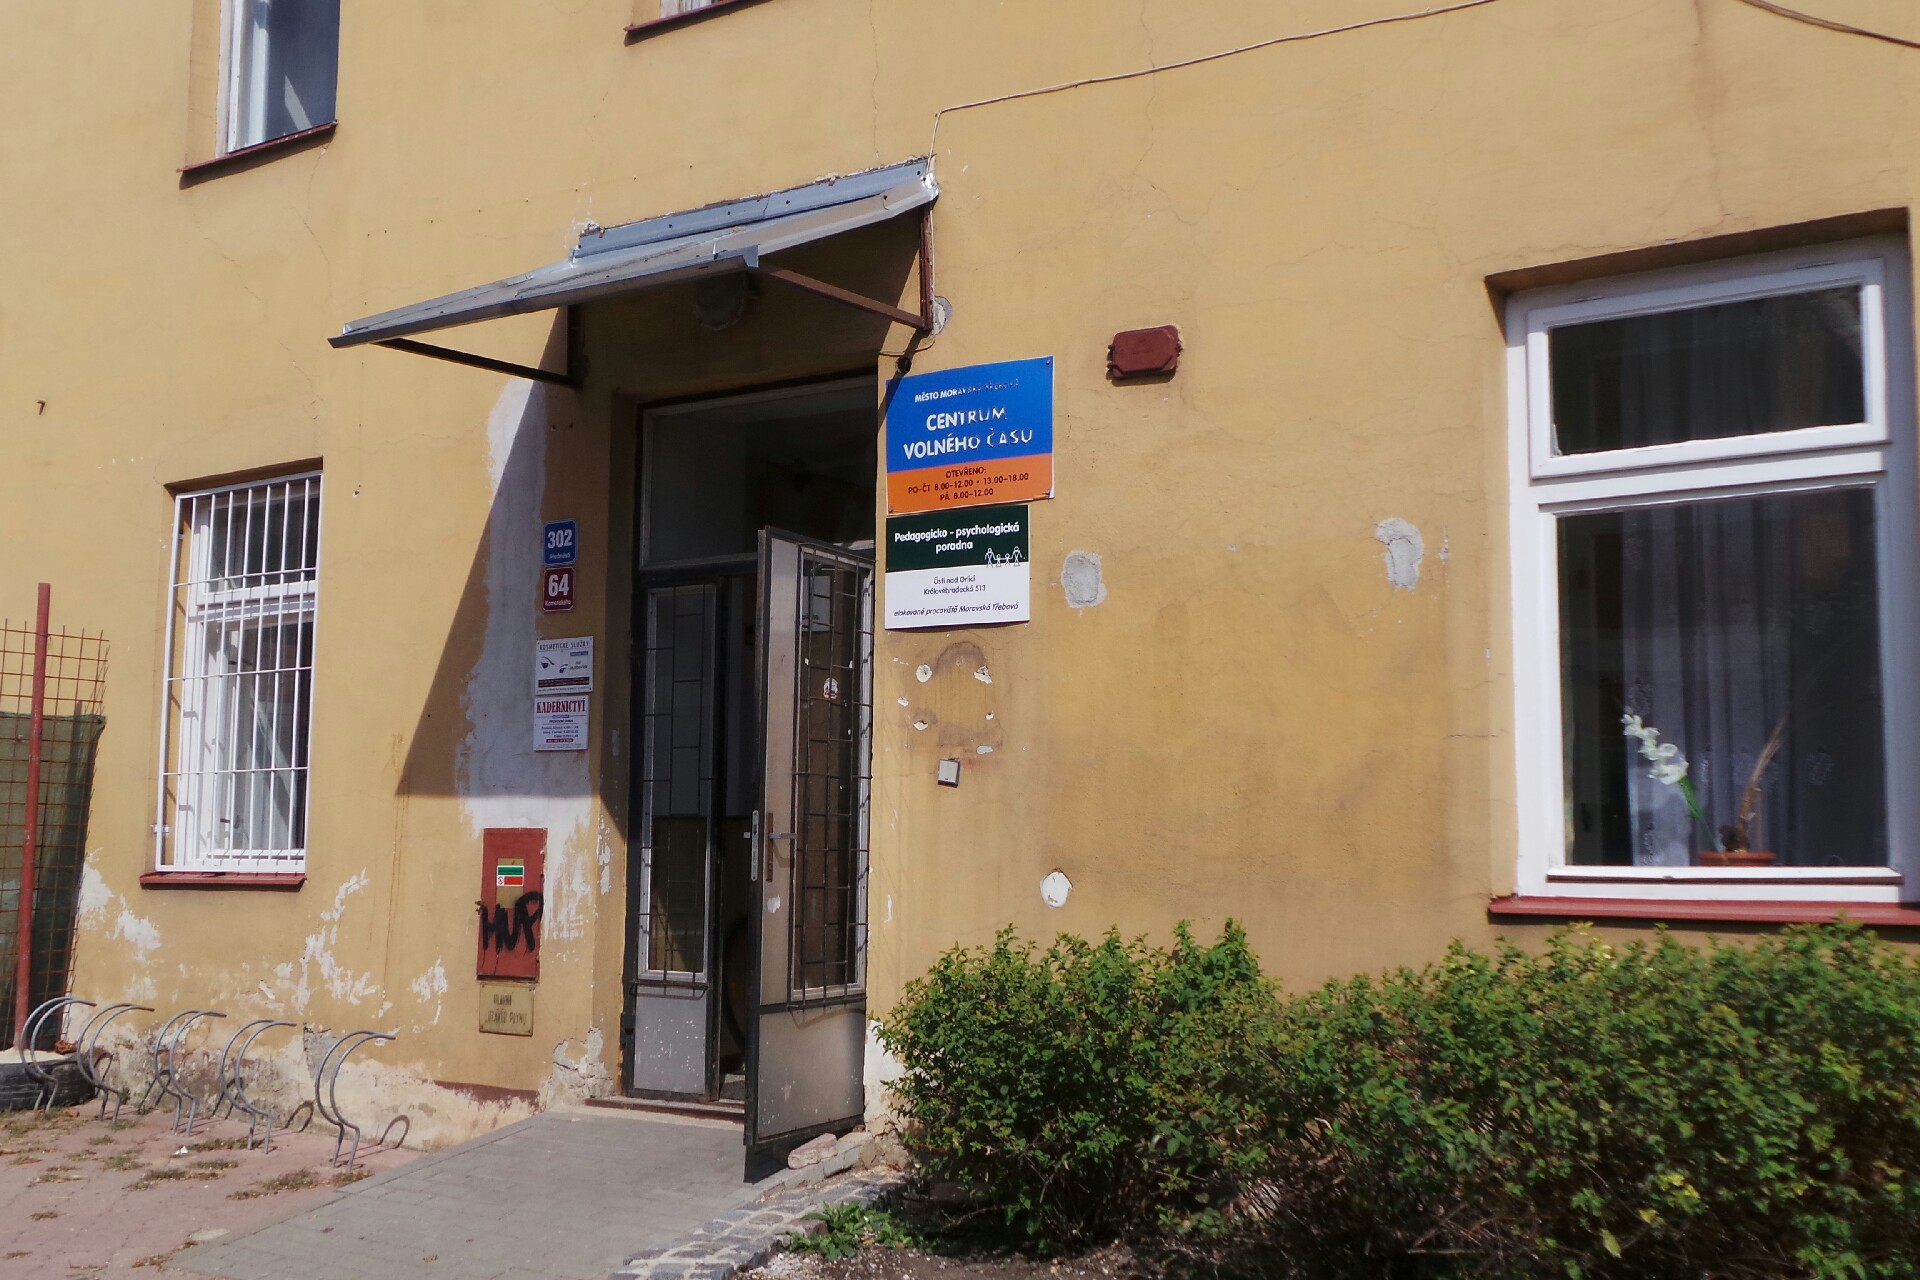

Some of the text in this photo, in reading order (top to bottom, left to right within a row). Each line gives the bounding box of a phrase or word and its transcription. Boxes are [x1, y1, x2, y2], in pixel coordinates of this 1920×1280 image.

[915, 391, 938, 403] MĚSTO
[926, 407, 1007, 431] CENTRUM
[904, 428, 1032, 460] VOLNÉHO ČASU
[946, 466, 986, 478] OTEVŘENO:
[908, 473, 1029, 494] PO-ČT 8.00-12.00 13.00-18.00
[940, 488, 994, 501] PÁ 8.00-12.00
[547, 529, 573, 549] 302
[894, 528, 948, 543] Pedagogicko
[955, 521, 1020, 539] psychologická
[936, 540, 974, 554] poradna
[548, 573, 569, 597] 64
[975, 584, 986, 592] 513
[958, 603, 991, 613] Moravská
[992, 602, 1019, 611] Třebová
[536, 697, 586, 713] KADEŘNICTVÍ
